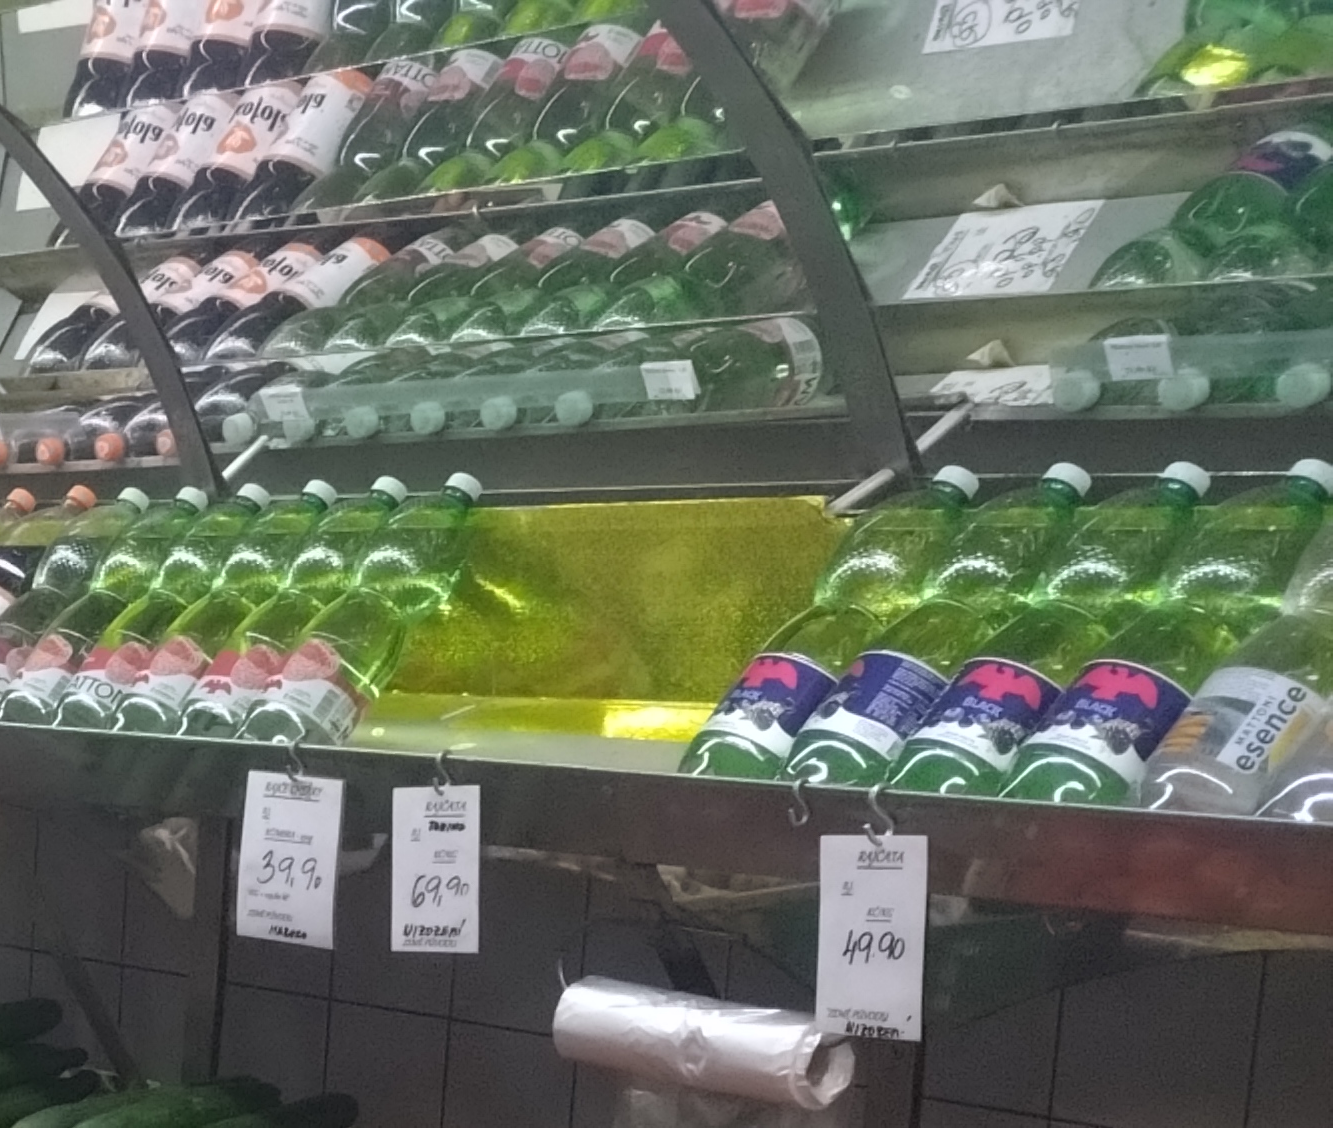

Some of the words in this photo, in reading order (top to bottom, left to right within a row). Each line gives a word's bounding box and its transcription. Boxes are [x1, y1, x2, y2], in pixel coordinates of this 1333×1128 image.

[962, 696, 1004, 718] BLACK
[1074, 698, 1118, 718] BLACK
[1234, 695, 1276, 746] MATTONI
[1235, 685, 1308, 772] esence
